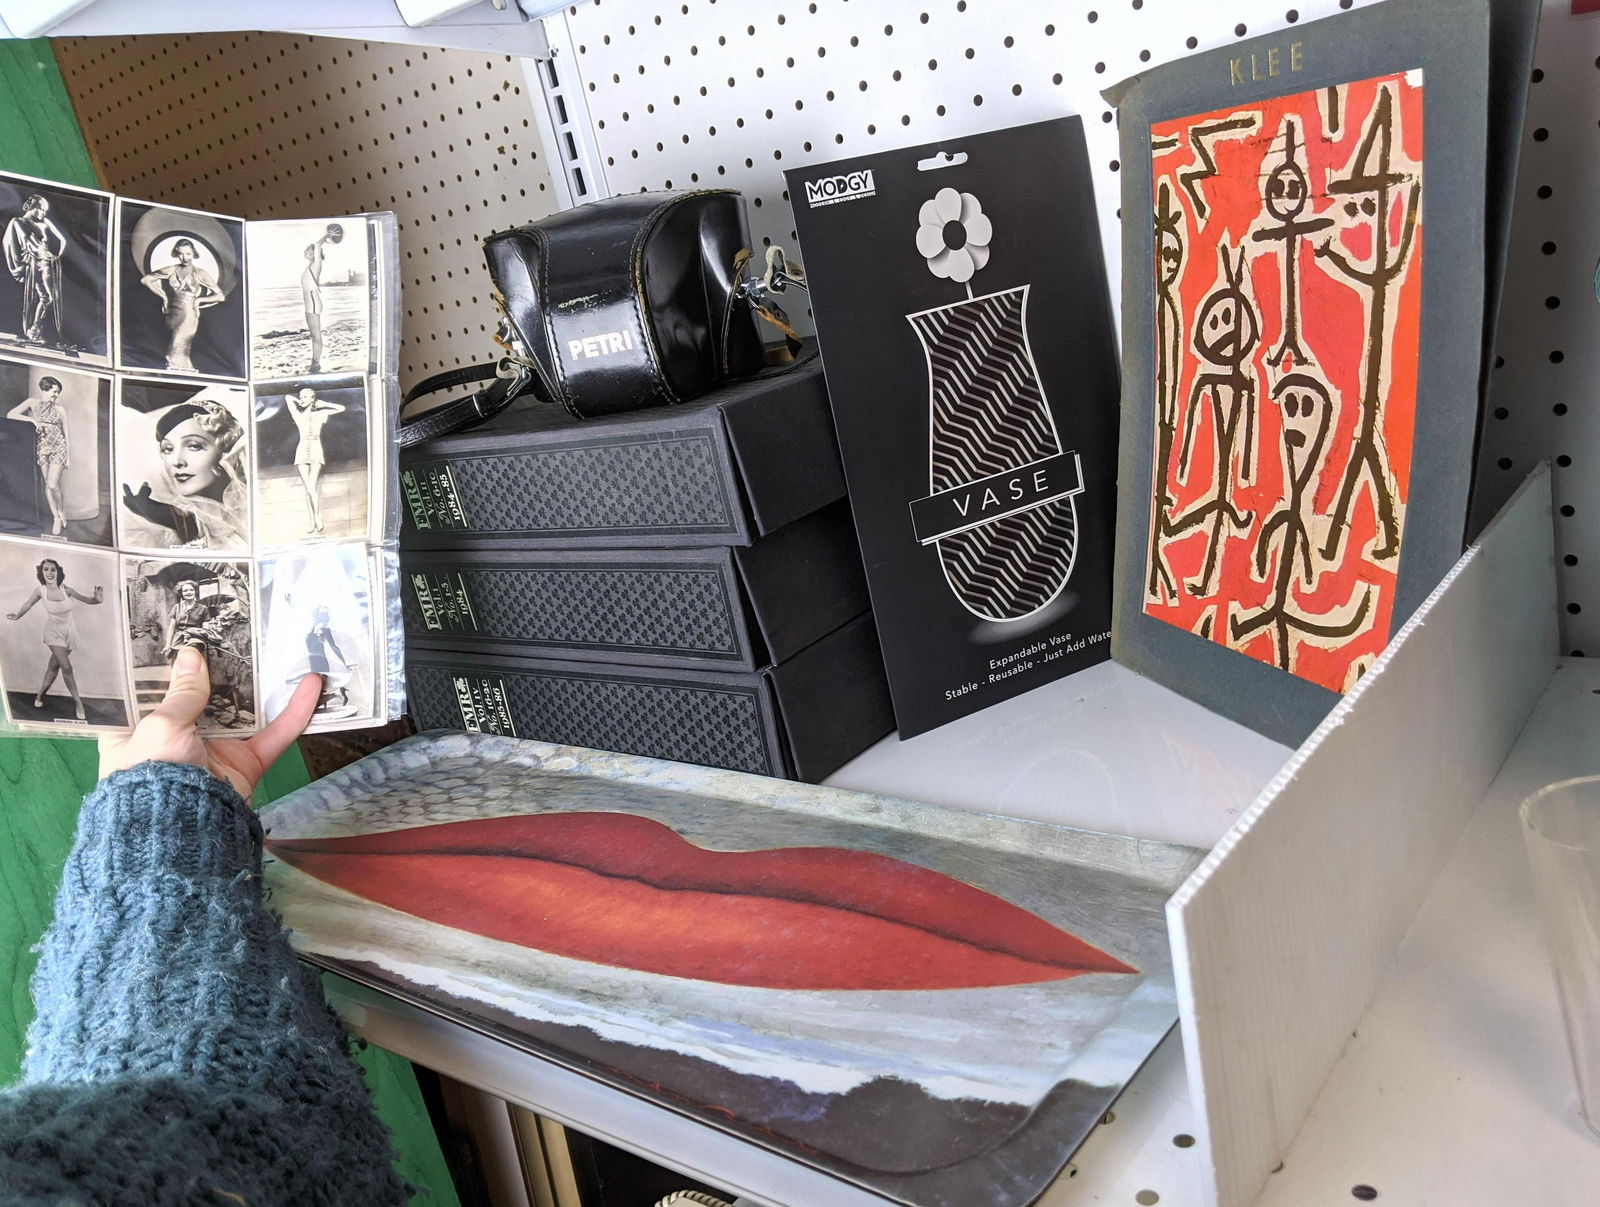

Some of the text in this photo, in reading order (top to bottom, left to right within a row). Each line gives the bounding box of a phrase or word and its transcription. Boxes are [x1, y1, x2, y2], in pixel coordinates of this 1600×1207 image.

[1230, 42, 1303, 87] KLEE
[807, 172, 869, 200] MODGY
[568, 330, 633, 361] PETRI
[408, 488, 428, 528] FMR
[952, 469, 1049, 517] VASE
[419, 590, 440, 628] FMR
[945, 681, 978, 701] Stable
[988, 660, 1033, 683] Reusable
[1043, 649, 1063, 663] Just
[1066, 640, 1085, 653] Add
[1088, 631, 1111, 645] Wate
[989, 632, 1072, 670] Expandable Vase
[460, 694, 479, 731] FMR
